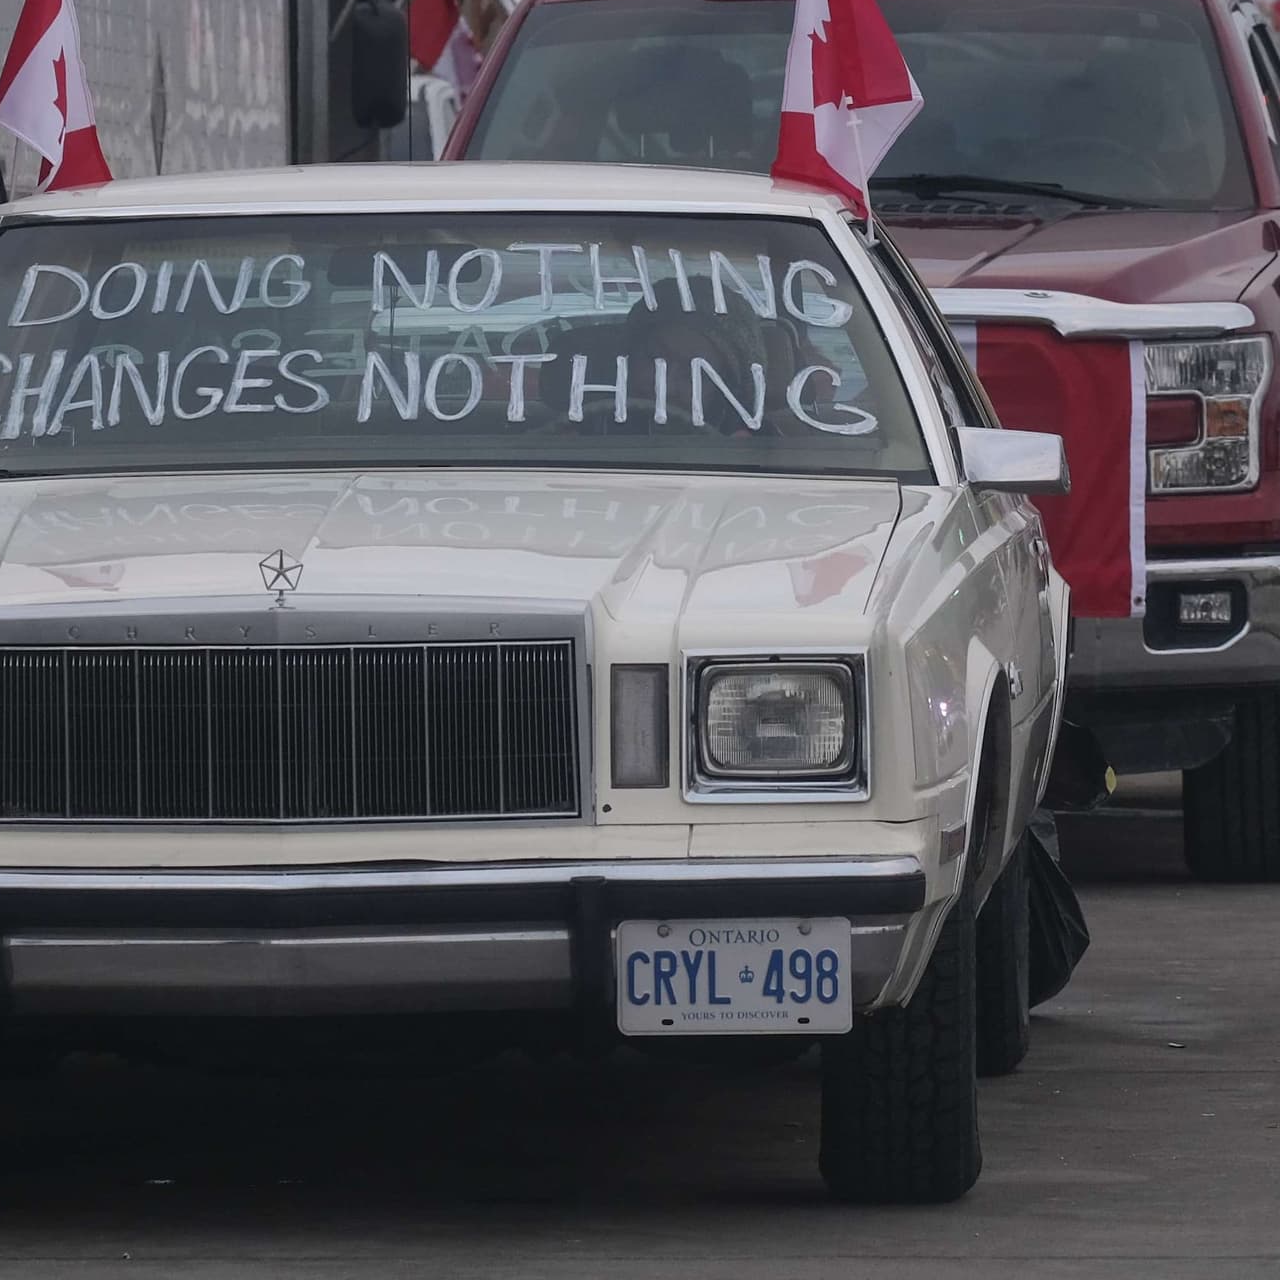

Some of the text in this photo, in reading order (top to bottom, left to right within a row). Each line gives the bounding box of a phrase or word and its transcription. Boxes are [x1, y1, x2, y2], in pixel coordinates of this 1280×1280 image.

[7, 243, 853, 328] DOING NOTHING
[357, 351, 878, 435] NOTHING
[64, 621, 503, 641] CHRYSLER
[688, 928, 780, 947] ONTARIO
[627, 948, 840, 1006] CRYL 498
[681, 1010, 789, 1022] YOURS TO DISCOVER
